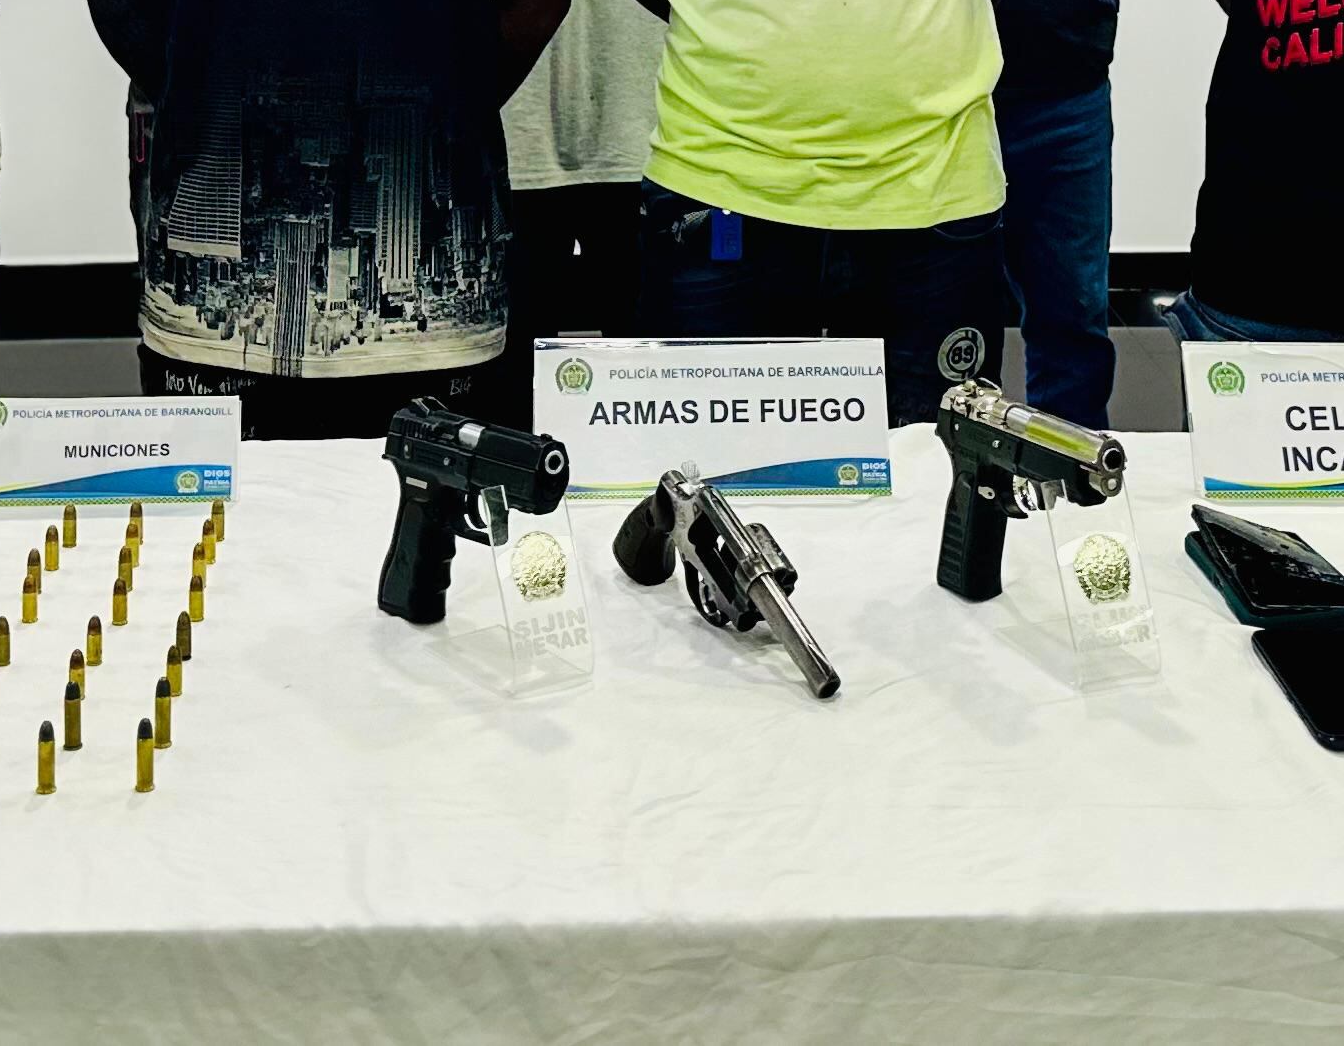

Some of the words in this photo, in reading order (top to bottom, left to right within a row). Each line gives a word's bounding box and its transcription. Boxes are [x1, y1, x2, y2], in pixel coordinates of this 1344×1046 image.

[661, 367, 764, 379] METROPOLITANA
[768, 367, 784, 378] DE
[788, 365, 884, 377] BARRANQUILLA
[56, 408, 142, 419] METROPOLITANA
[145, 408, 159, 418] DE
[589, 400, 699, 425] ARMAS
[710, 399, 749, 423] DE
[761, 397, 865, 422] FUEGO
[64, 443, 170, 458] MUNICIONES
[514, 607, 586, 639] SIJIN
